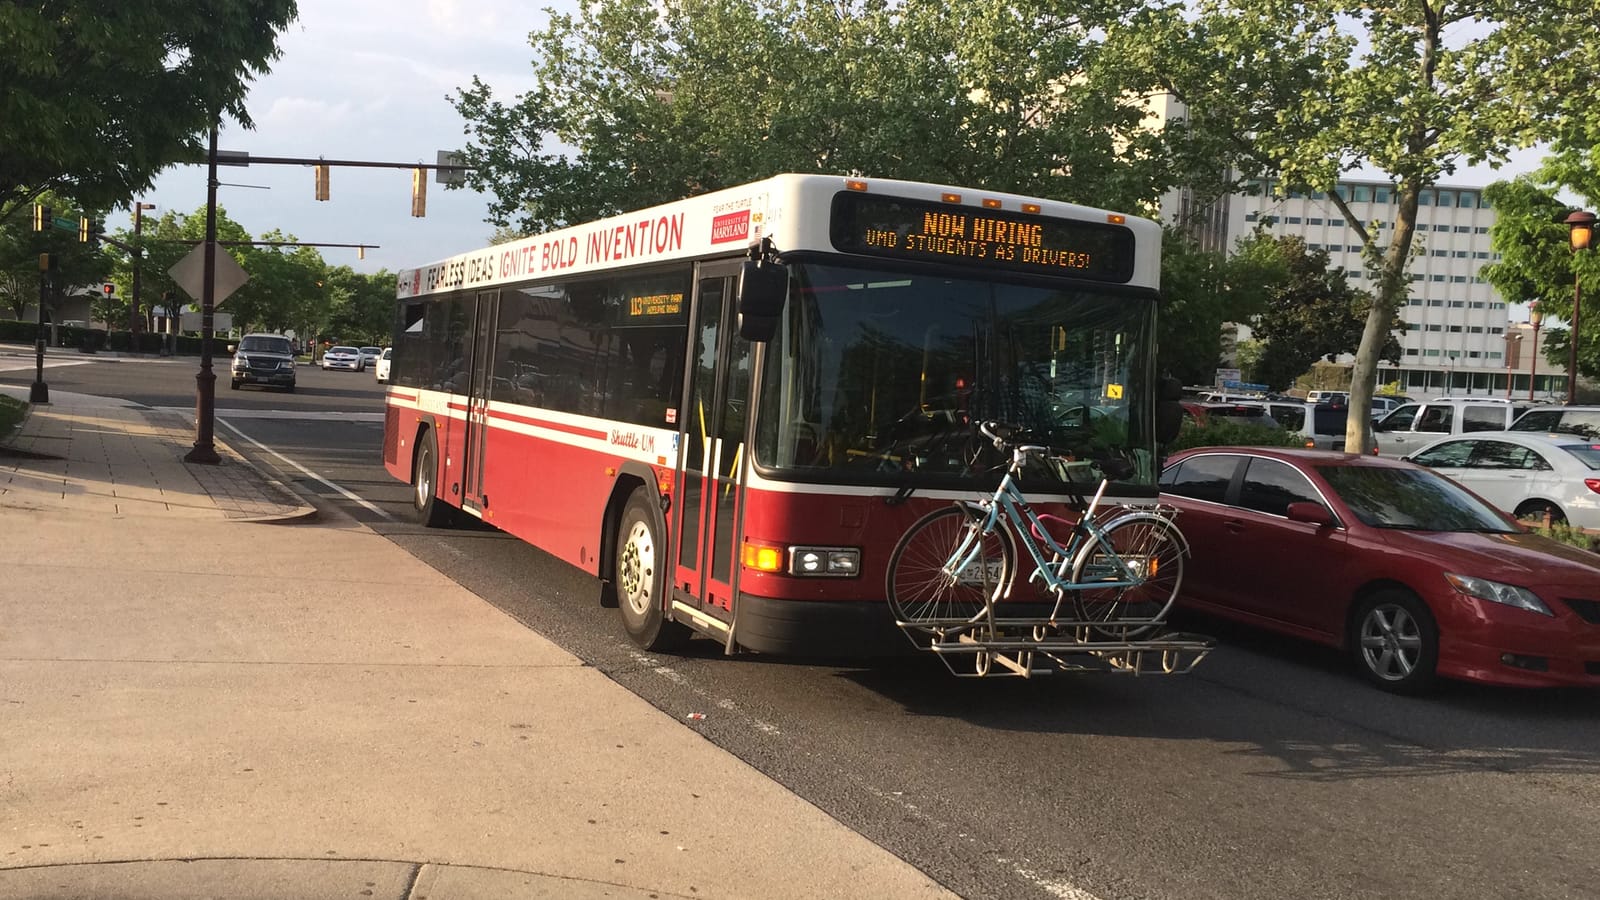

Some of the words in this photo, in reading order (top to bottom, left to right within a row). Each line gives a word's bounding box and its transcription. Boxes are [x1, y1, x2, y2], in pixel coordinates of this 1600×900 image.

[713, 222, 748, 240] MARYLAND
[714, 216, 741, 228] UNIVERSITY
[924, 212, 965, 238] NOW
[973, 218, 1042, 247] HIRING
[427, 260, 465, 290] FEARLESS
[468, 255, 494, 283] IDEAS
[499, 245, 536, 279] IGNITE
[541, 236, 578, 272] BOLD
[585, 212, 685, 264] INVENTION
[866, 229, 897, 248] UMD
[905, 234, 987, 258] STUDENTS
[995, 245, 1015, 261] AS
[1023, 247, 1090, 269] DRIVERS!
[630, 296, 643, 315] 113
